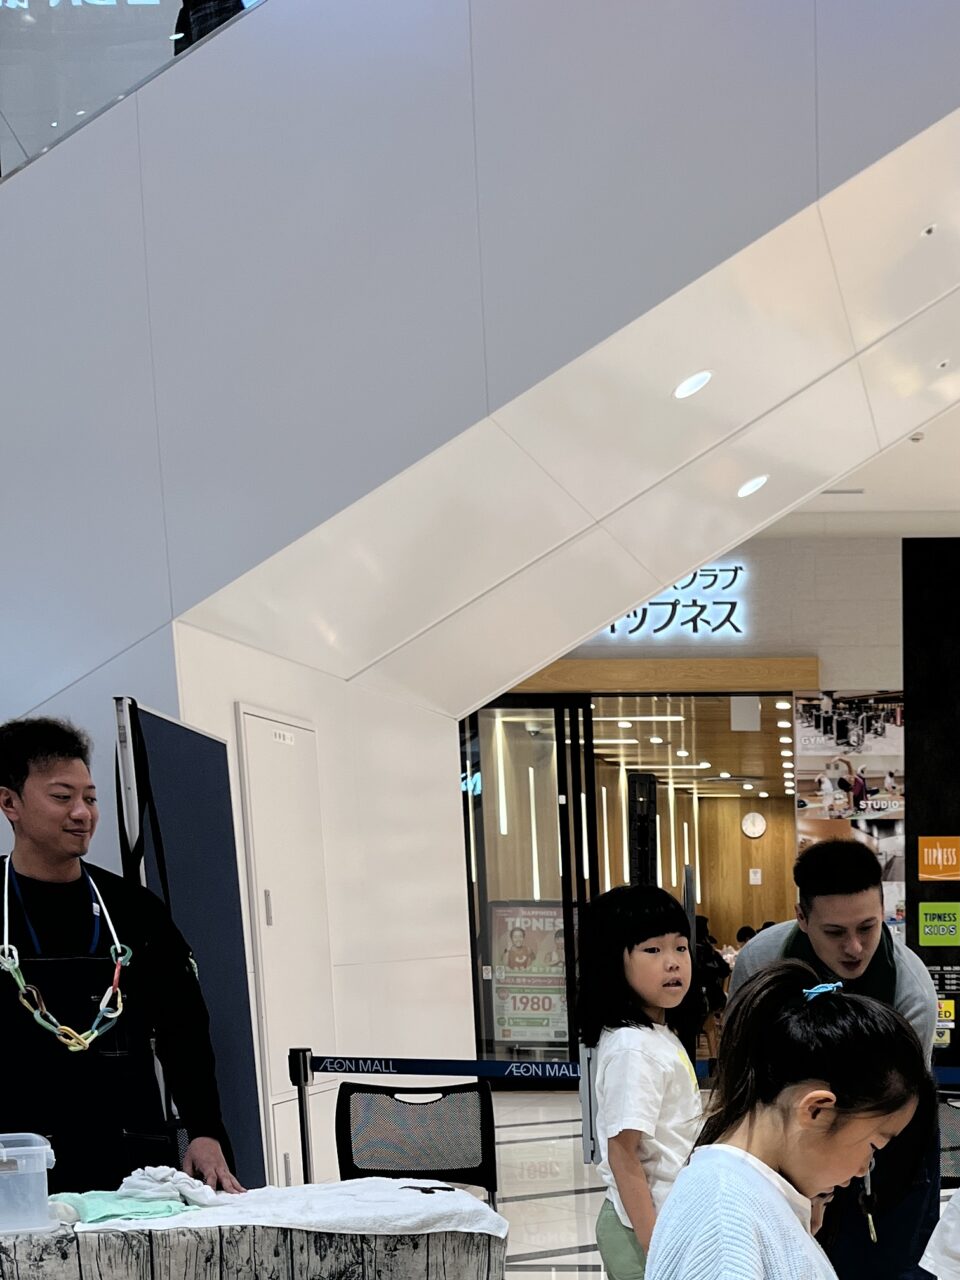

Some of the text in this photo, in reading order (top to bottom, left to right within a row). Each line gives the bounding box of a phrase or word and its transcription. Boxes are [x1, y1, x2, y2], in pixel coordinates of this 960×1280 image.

[801, 736, 826, 745] GYM
[859, 800, 900, 810] STUDIO
[923, 846, 957, 866] TIPNESS
[924, 912, 957, 922] TIPNESS
[505, 917, 564, 931] TIPNES
[924, 925, 957, 935] KIDS
[937, 1010, 952, 1019] ED
[359, 1060, 397, 1073] MALL
[546, 1064, 581, 1077] MALL
